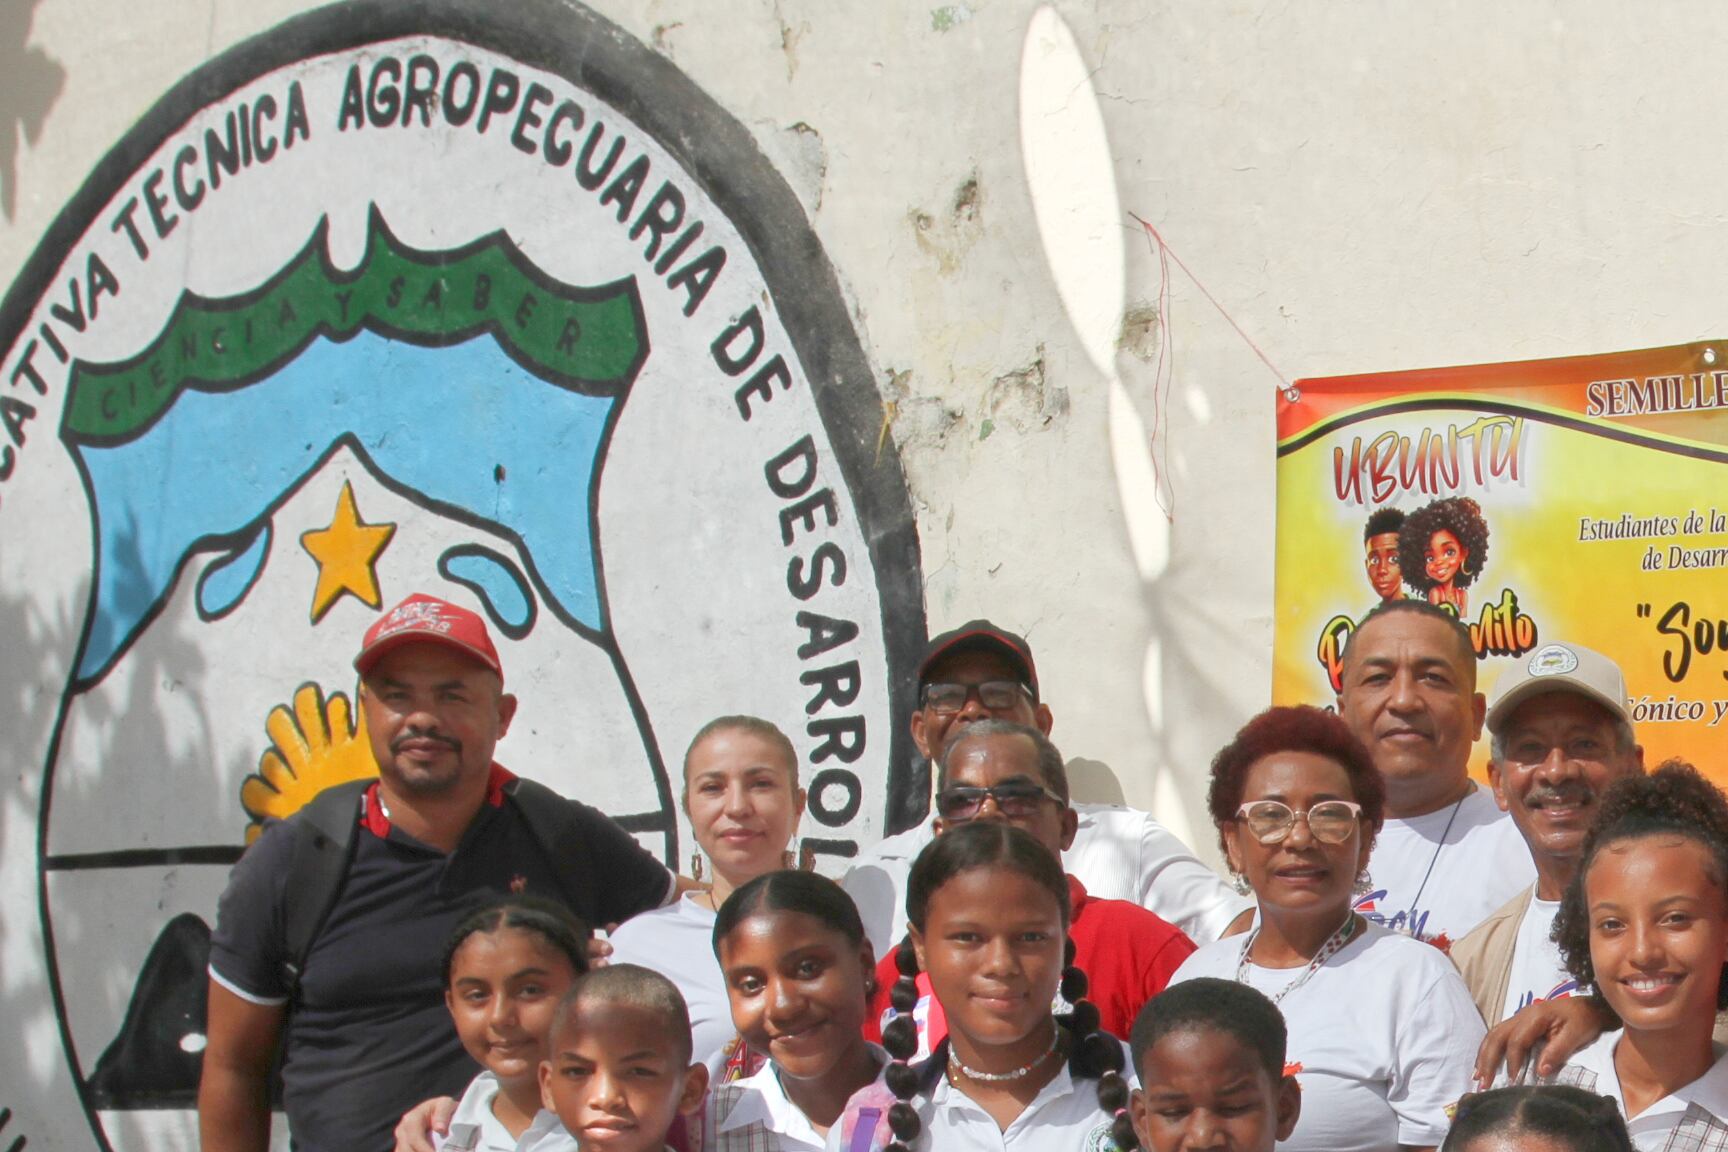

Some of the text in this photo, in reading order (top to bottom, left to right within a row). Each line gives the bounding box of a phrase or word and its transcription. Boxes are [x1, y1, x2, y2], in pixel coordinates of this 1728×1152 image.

[102, 273, 583, 421] CIENCIA Y SABER
[110, 81, 309, 261] TECNICA
[338, 54, 728, 318] AGROPECUARIA
[710, 304, 792, 421] DE
[764, 433, 861, 858] DESARROL
[1333, 416, 1524, 504] UBUNTU
[1578, 513, 1678, 541] Estudiantes
[1682, 511, 1705, 535] de
[1708, 508, 1727, 533] la
[1642, 546, 1664, 571] de
[1628, 695, 1706, 724] ónico
